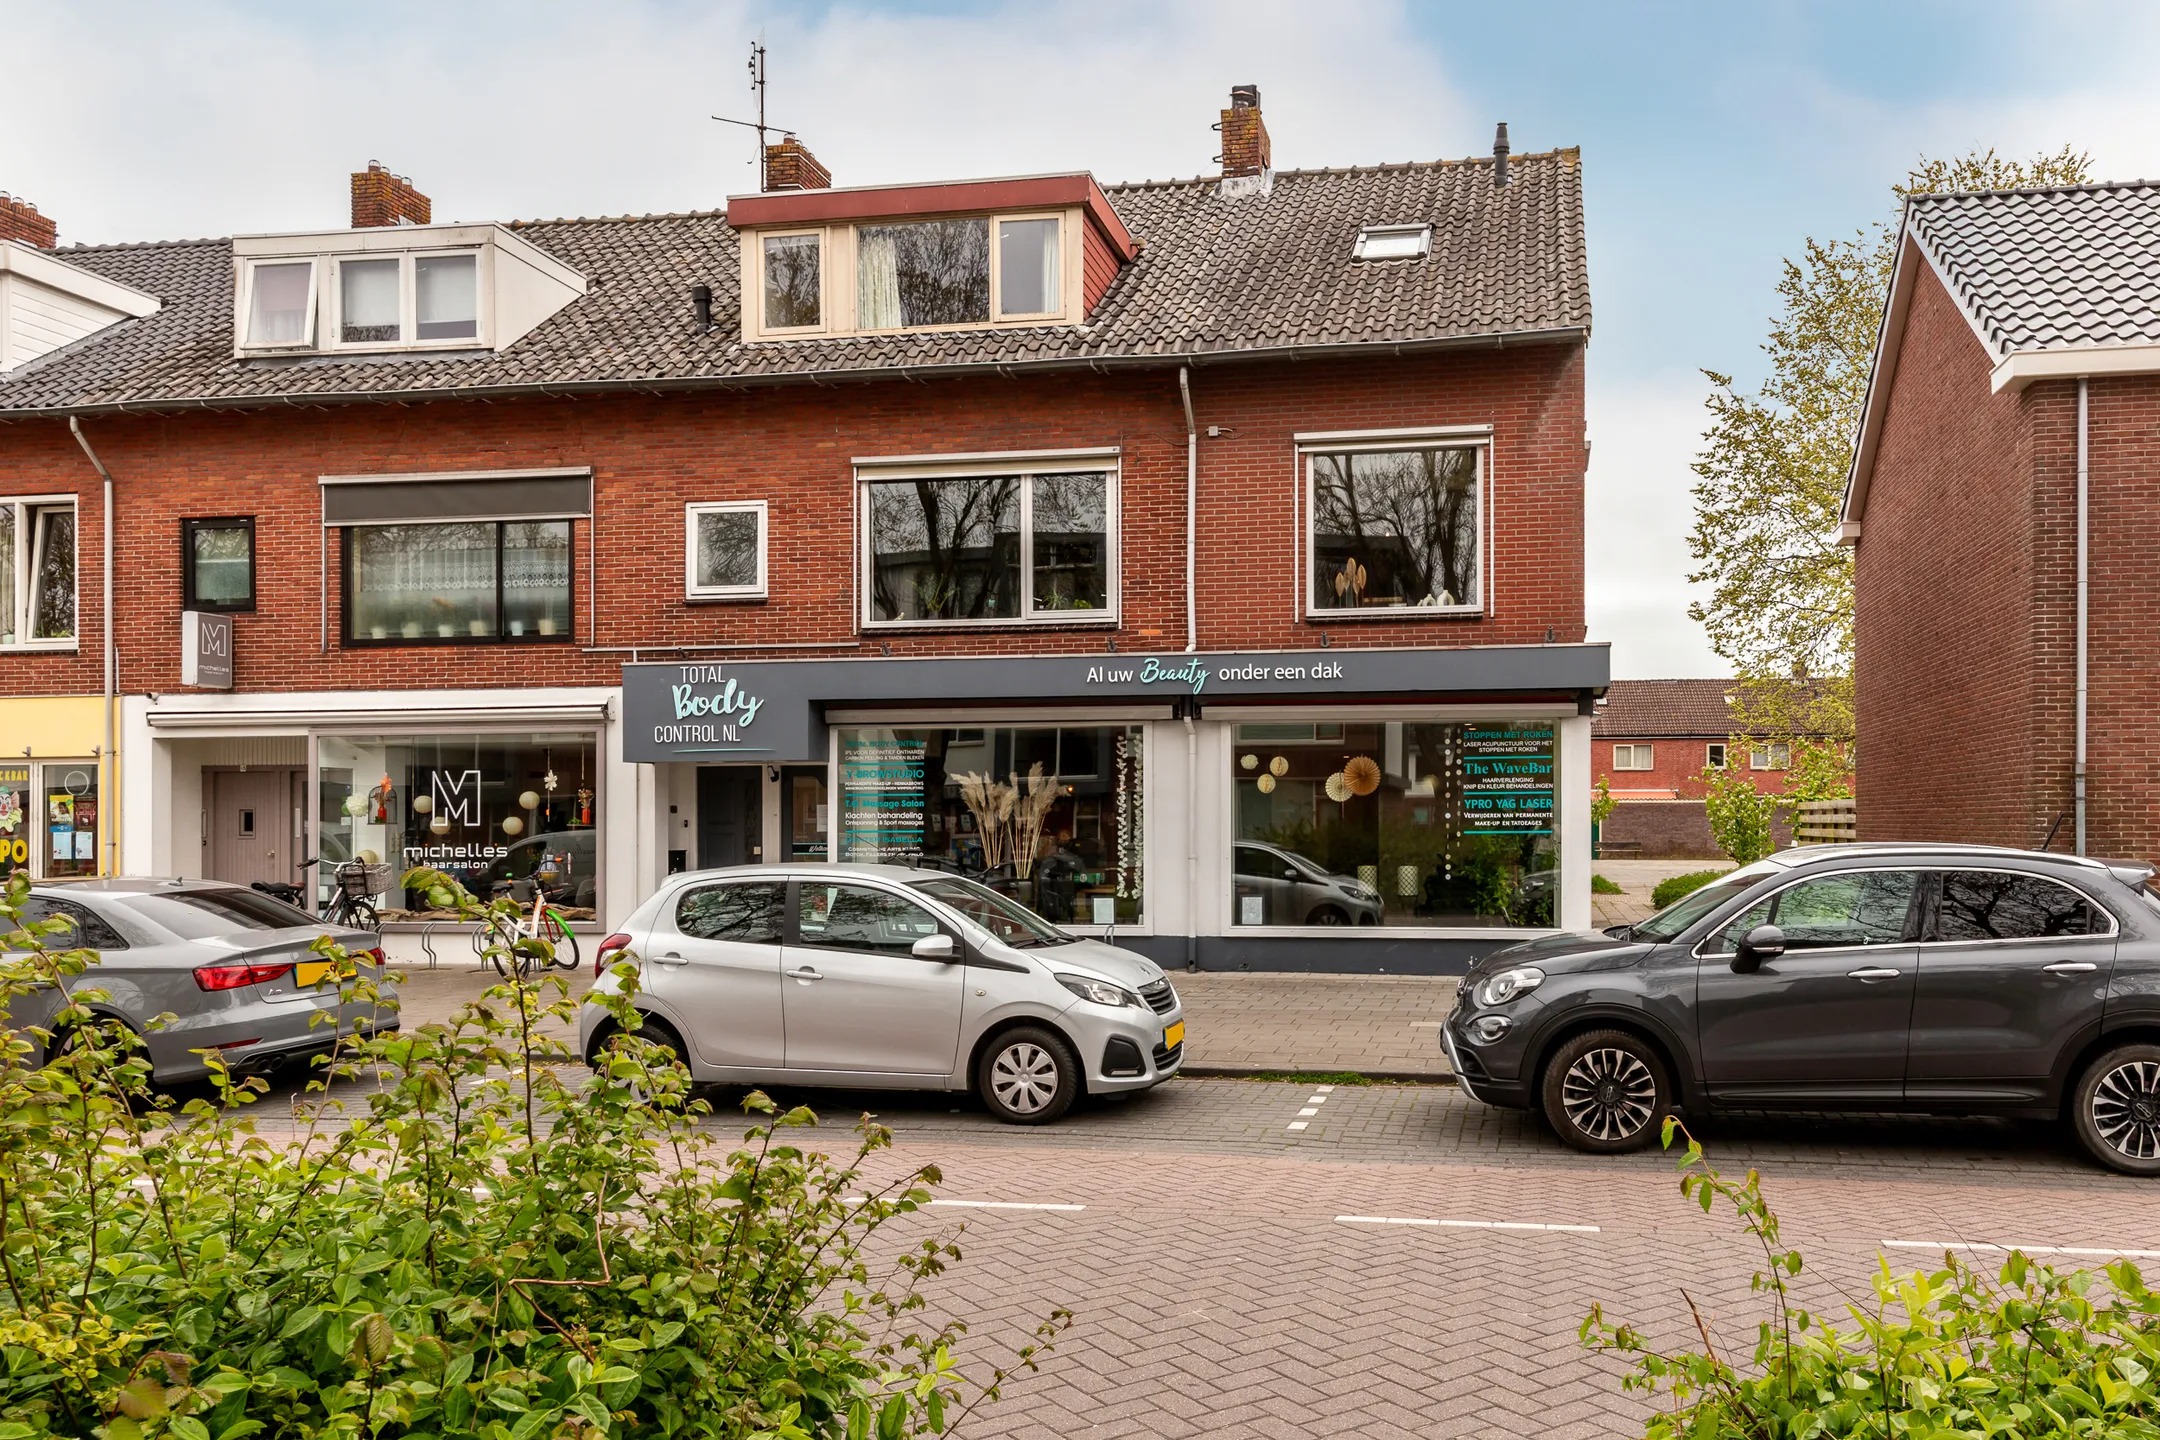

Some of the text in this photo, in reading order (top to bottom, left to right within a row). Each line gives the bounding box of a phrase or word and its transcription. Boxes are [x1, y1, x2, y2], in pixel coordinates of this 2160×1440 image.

[202, 622, 226, 657] M
[198, 664, 230, 673] michelles
[680, 666, 726, 683] TOTAL
[1086, 658, 1343, 695] Al uw Beauty onder een dak
[672, 678, 765, 728] Body
[654, 724, 741, 743] CONTROL NL
[1463, 731, 1501, 739] STOPPEN
[1523, 730, 1553, 738] ROKEN
[1463, 762, 1553, 775] The WaveBar
[432, 770, 481, 827] M
[862, 800, 899, 809] Massage
[901, 800, 925, 808] Salon
[1464, 798, 1553, 809] YPRO YAG LASER
[877, 812, 923, 820] behandeling
[403, 843, 508, 858] michelles
[423, 860, 488, 869] haarsalon
